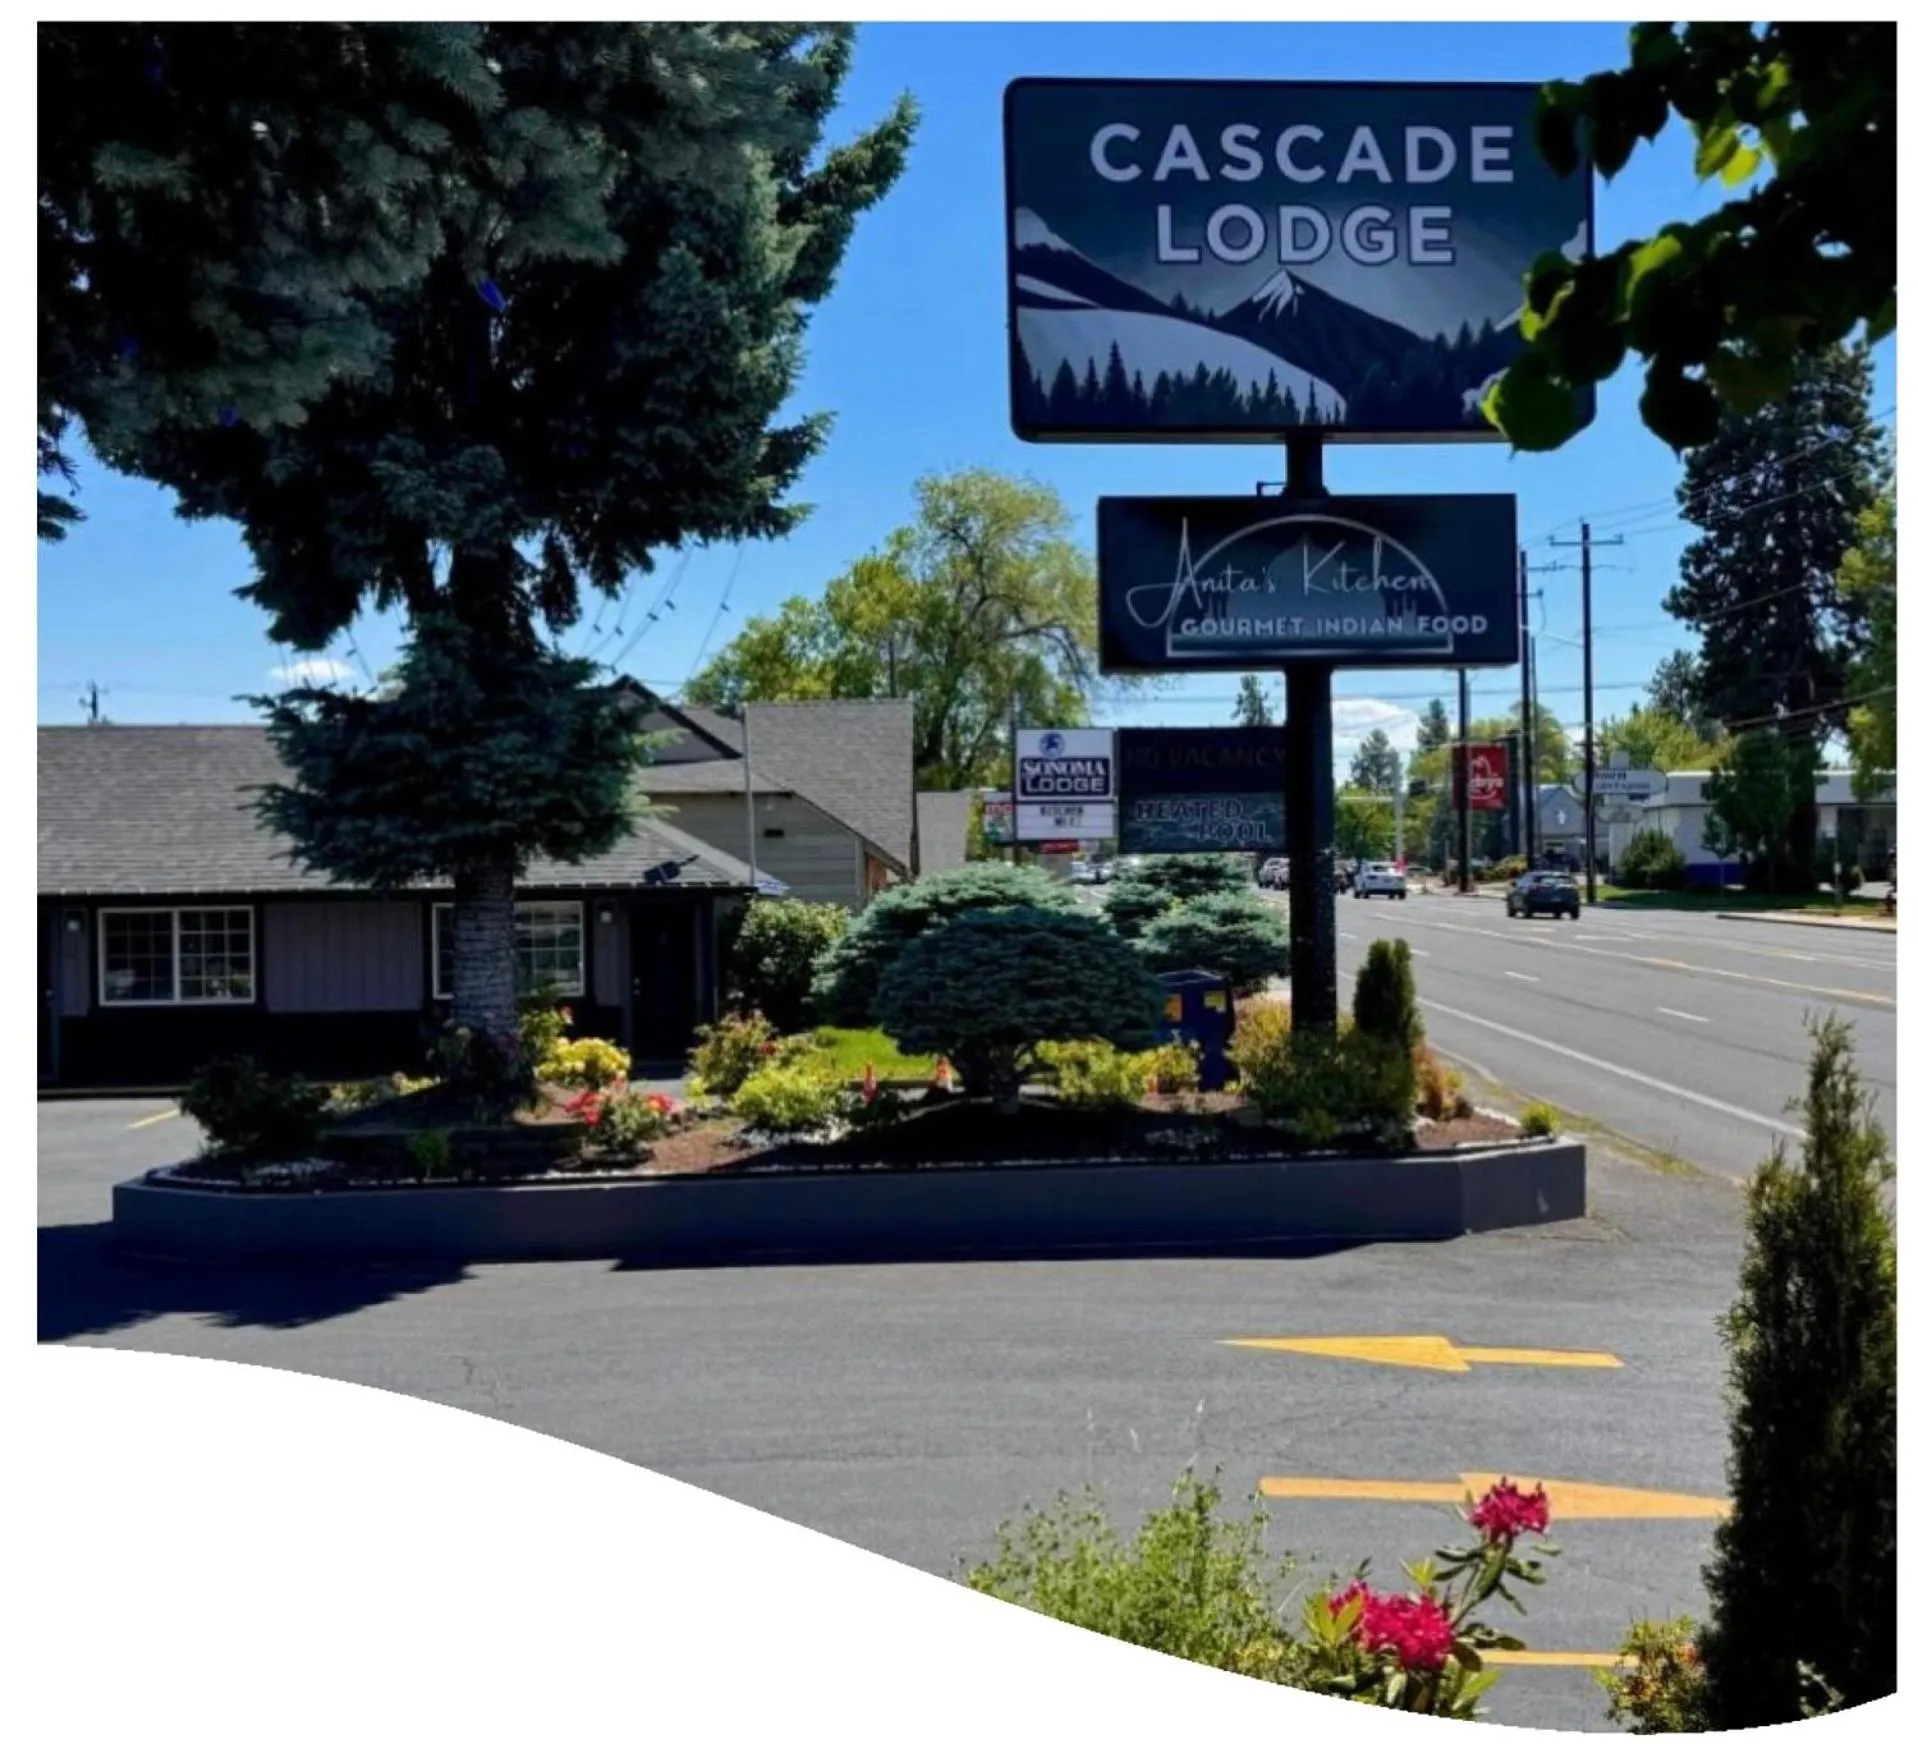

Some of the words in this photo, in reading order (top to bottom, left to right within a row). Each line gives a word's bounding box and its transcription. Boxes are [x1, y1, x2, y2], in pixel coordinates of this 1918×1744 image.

[1090, 123, 1515, 183] CASCADE
[1156, 204, 1454, 264] LODGE
[1126, 516, 1276, 628] Anita's
[1304, 536, 1431, 597] Kitchen
[1180, 617, 1302, 636] GOURMET
[1316, 616, 1403, 635] INDIAN
[1417, 615, 1489, 634] FOOD
[1022, 760, 1106, 776] SONOMA
[1026, 777, 1105, 793] LODGE
[1136, 800, 1246, 821] HEATED
